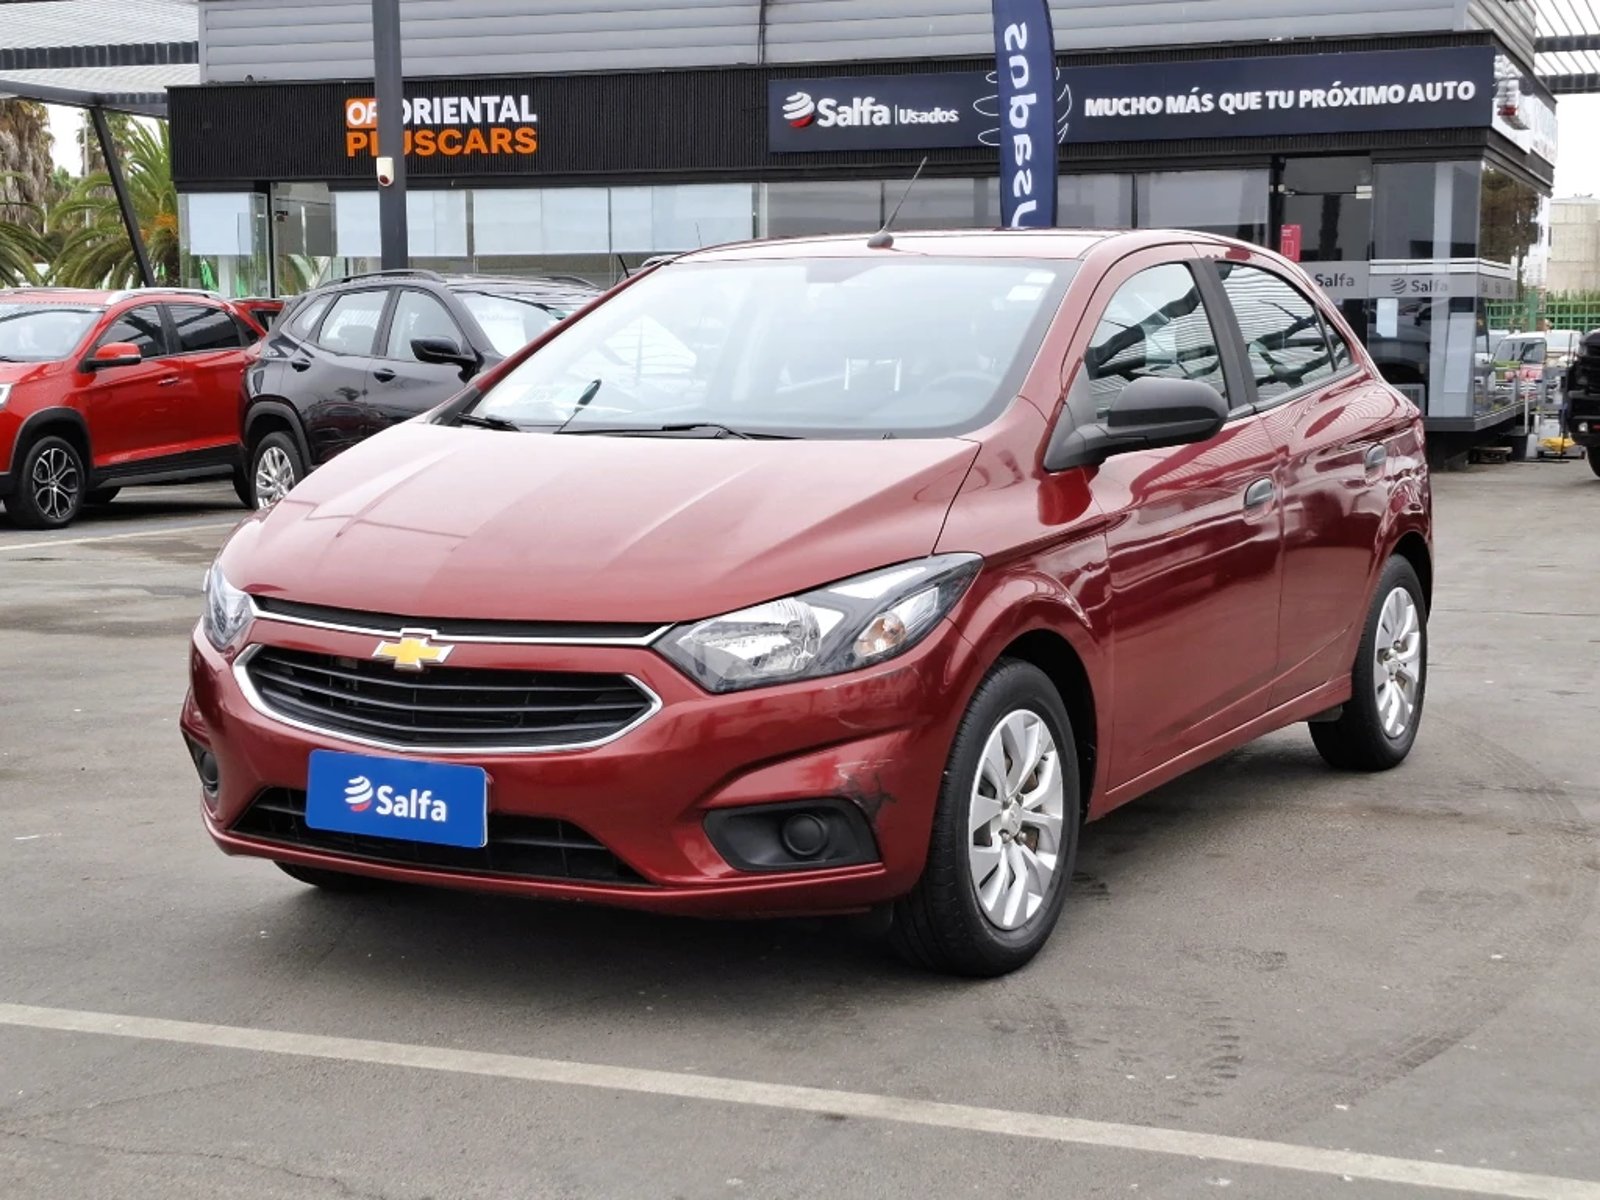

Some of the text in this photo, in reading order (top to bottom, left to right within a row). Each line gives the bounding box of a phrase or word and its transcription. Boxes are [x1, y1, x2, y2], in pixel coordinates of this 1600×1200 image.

[817, 96, 960, 127] Salfa Usados
[1085, 81, 1476, 117] MUCHO MÁS QUE TU PRÓXIMO AUTO
[1314, 272, 1355, 288] Salfa
[1411, 279, 1449, 293] Salfa
[376, 785, 447, 822] Salfa
